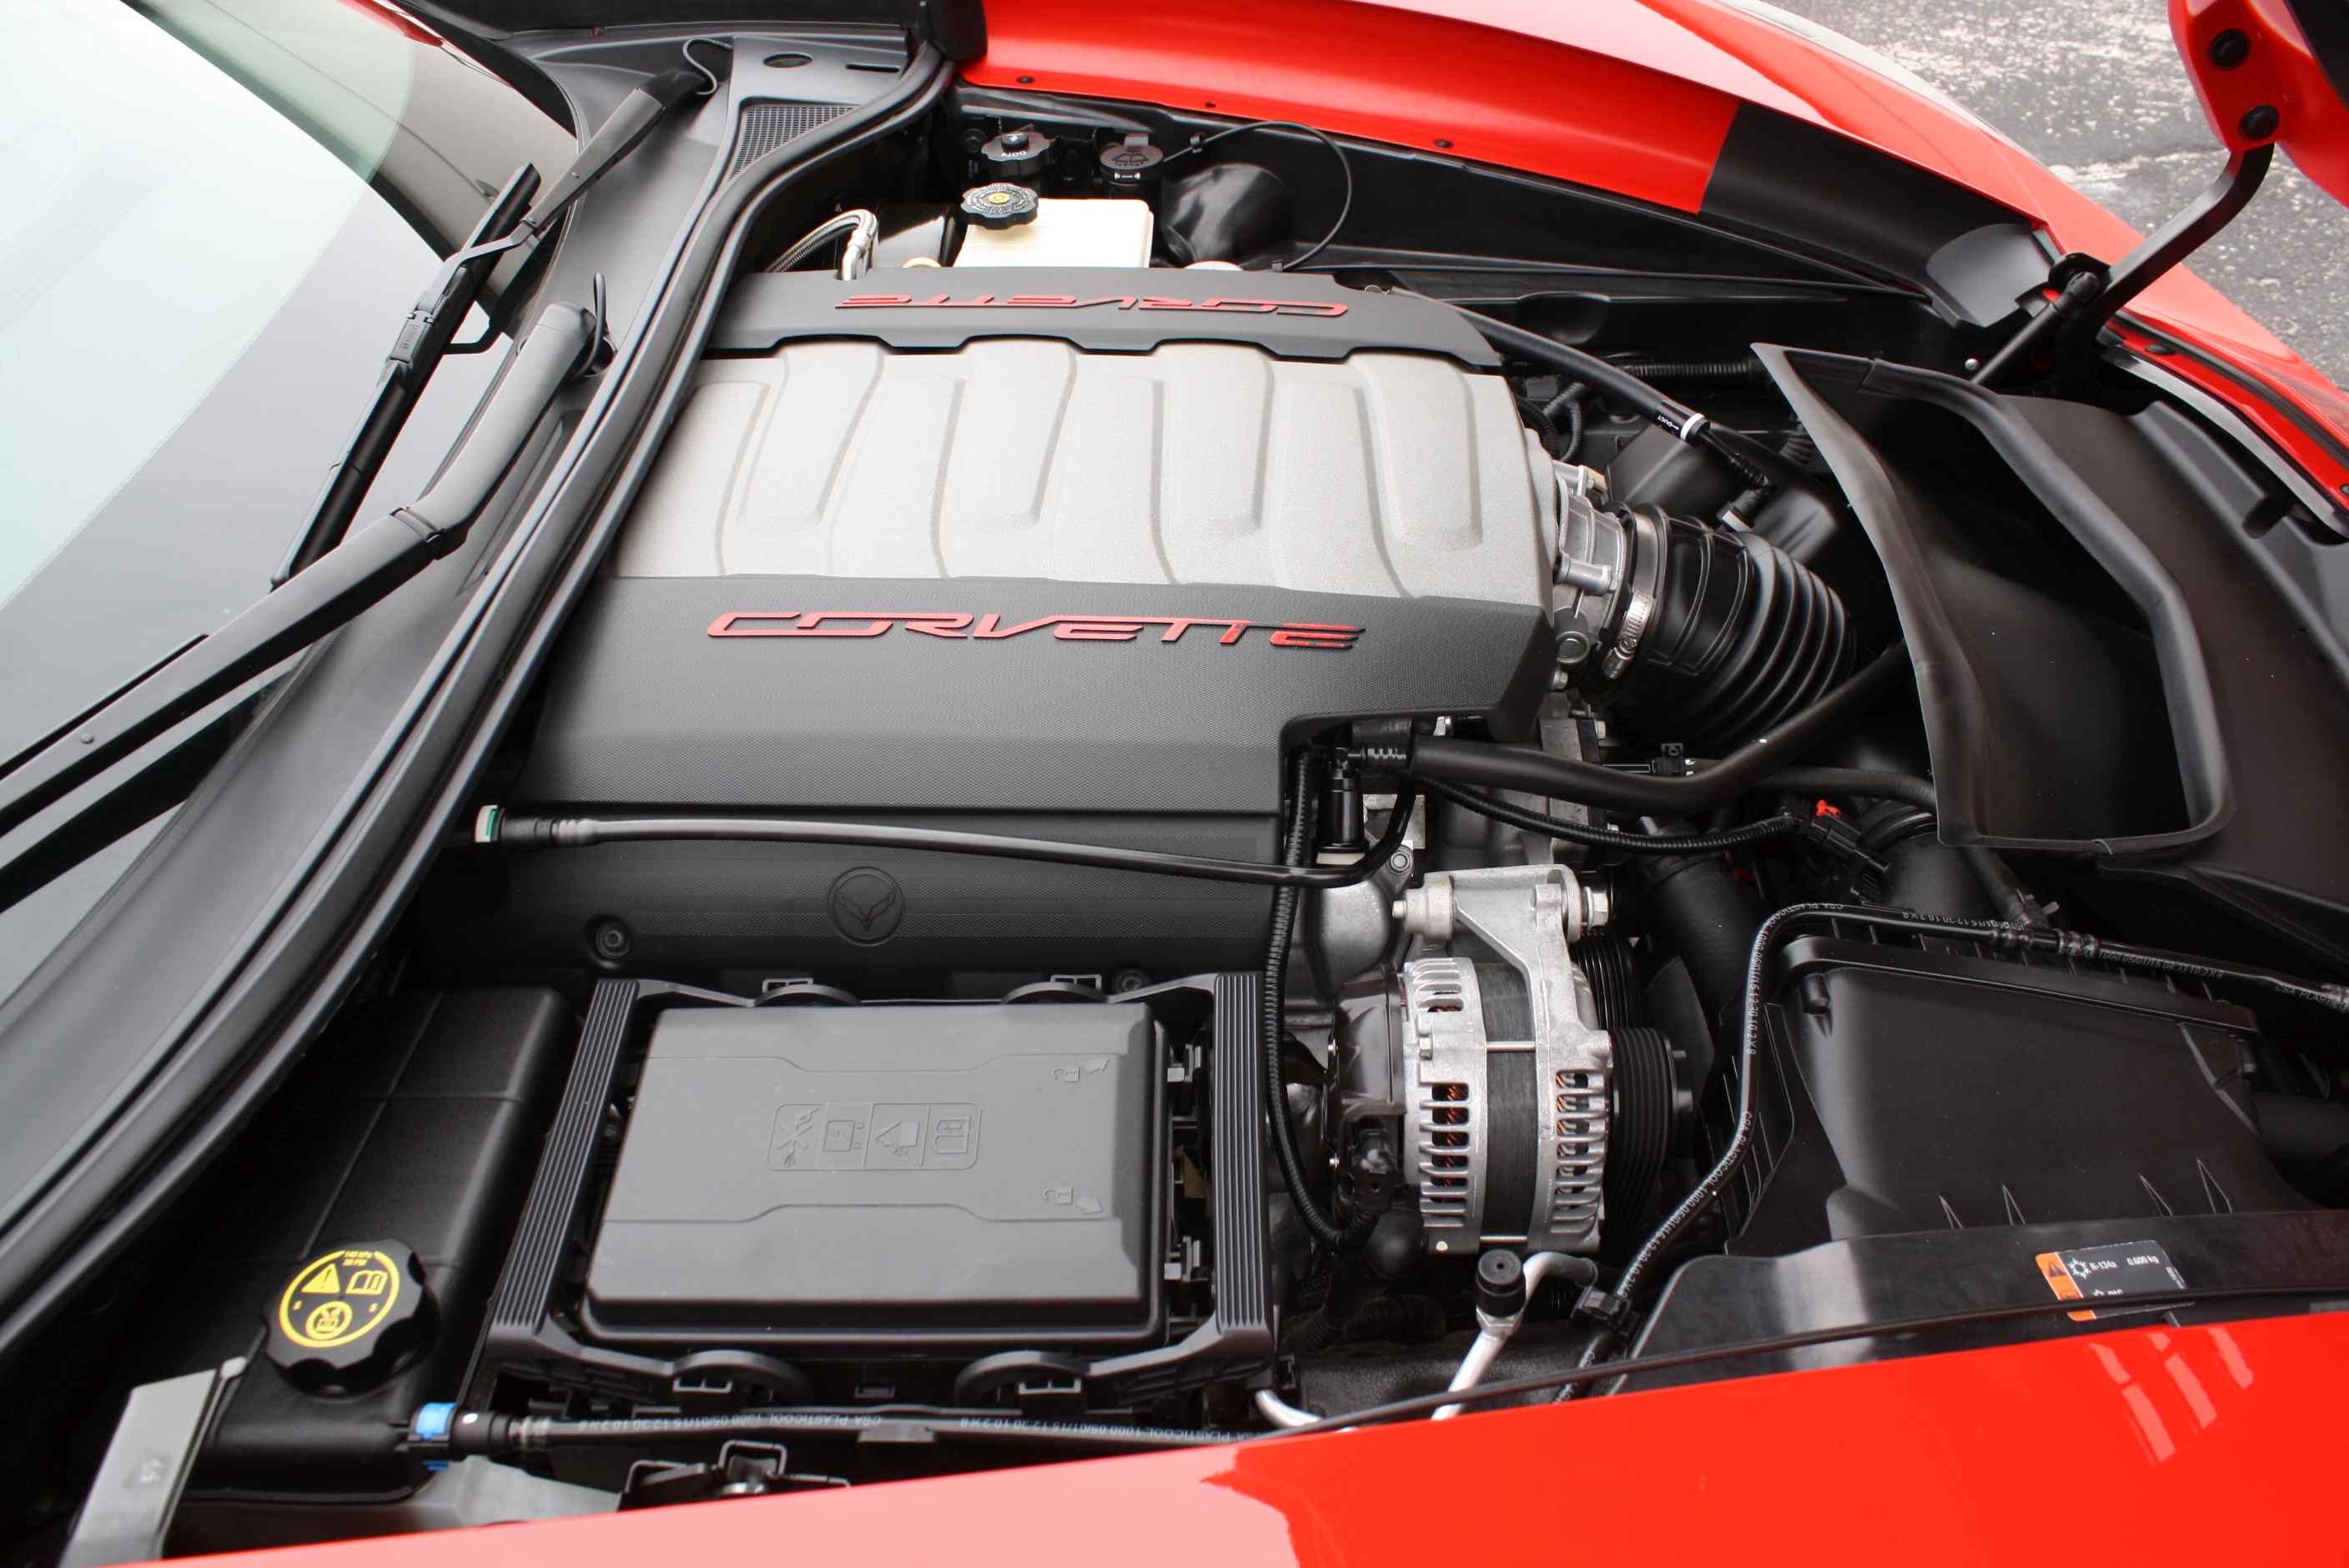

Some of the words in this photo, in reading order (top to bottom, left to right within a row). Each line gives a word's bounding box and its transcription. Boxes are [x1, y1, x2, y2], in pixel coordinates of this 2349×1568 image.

[836, 294, 1349, 318] CORVETTE
[707, 611, 1366, 650] CORVETTE
[1149, 1428, 1230, 1441] PLASTICOOL
